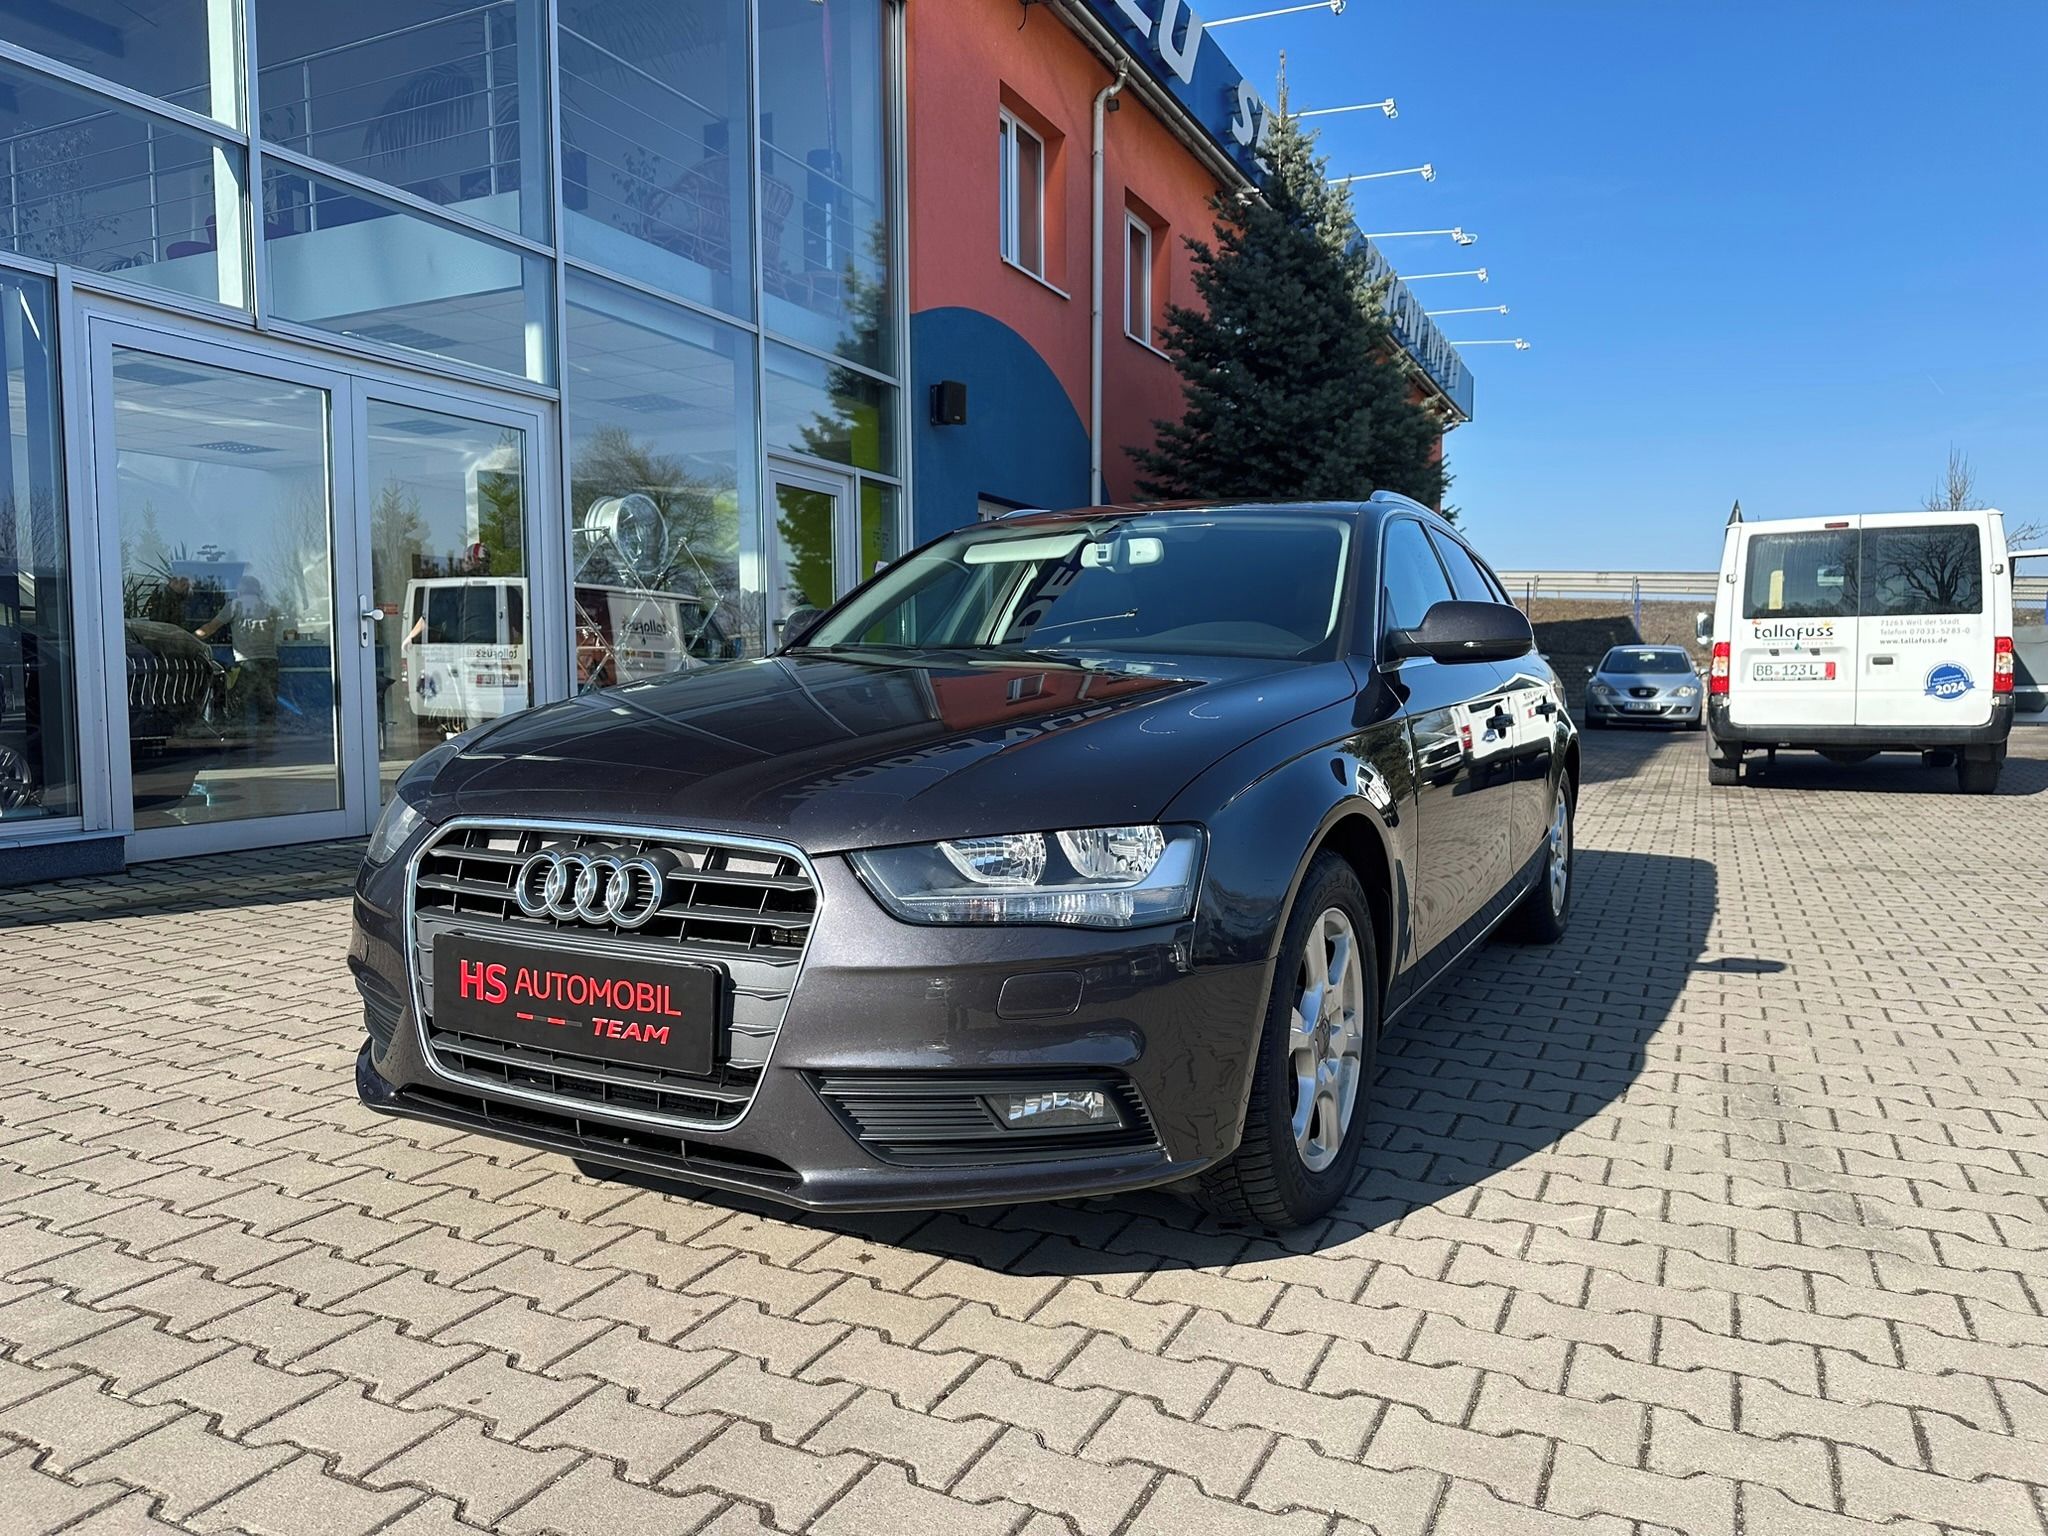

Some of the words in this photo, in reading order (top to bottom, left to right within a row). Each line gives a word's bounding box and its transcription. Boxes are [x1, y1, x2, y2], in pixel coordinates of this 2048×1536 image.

[1906, 618, 1922, 626] Weil
[1924, 618, 1937, 626] der
[1939, 617, 1960, 625] Stadt
[1754, 624, 1834, 641] tallafuss
[1880, 628, 1907, 636] Telefon
[1879, 637, 1948, 645] www.tallafuss.de
[1756, 664, 1773, 676] BB
[1782, 664, 1807, 676] 123
[1809, 664, 1818, 675] L
[1935, 681, 1967, 696] 2024
[460, 959, 508, 1004] HS
[513, 967, 682, 1017] AUTOMOBIL
[591, 1017, 670, 1045] TEAM
